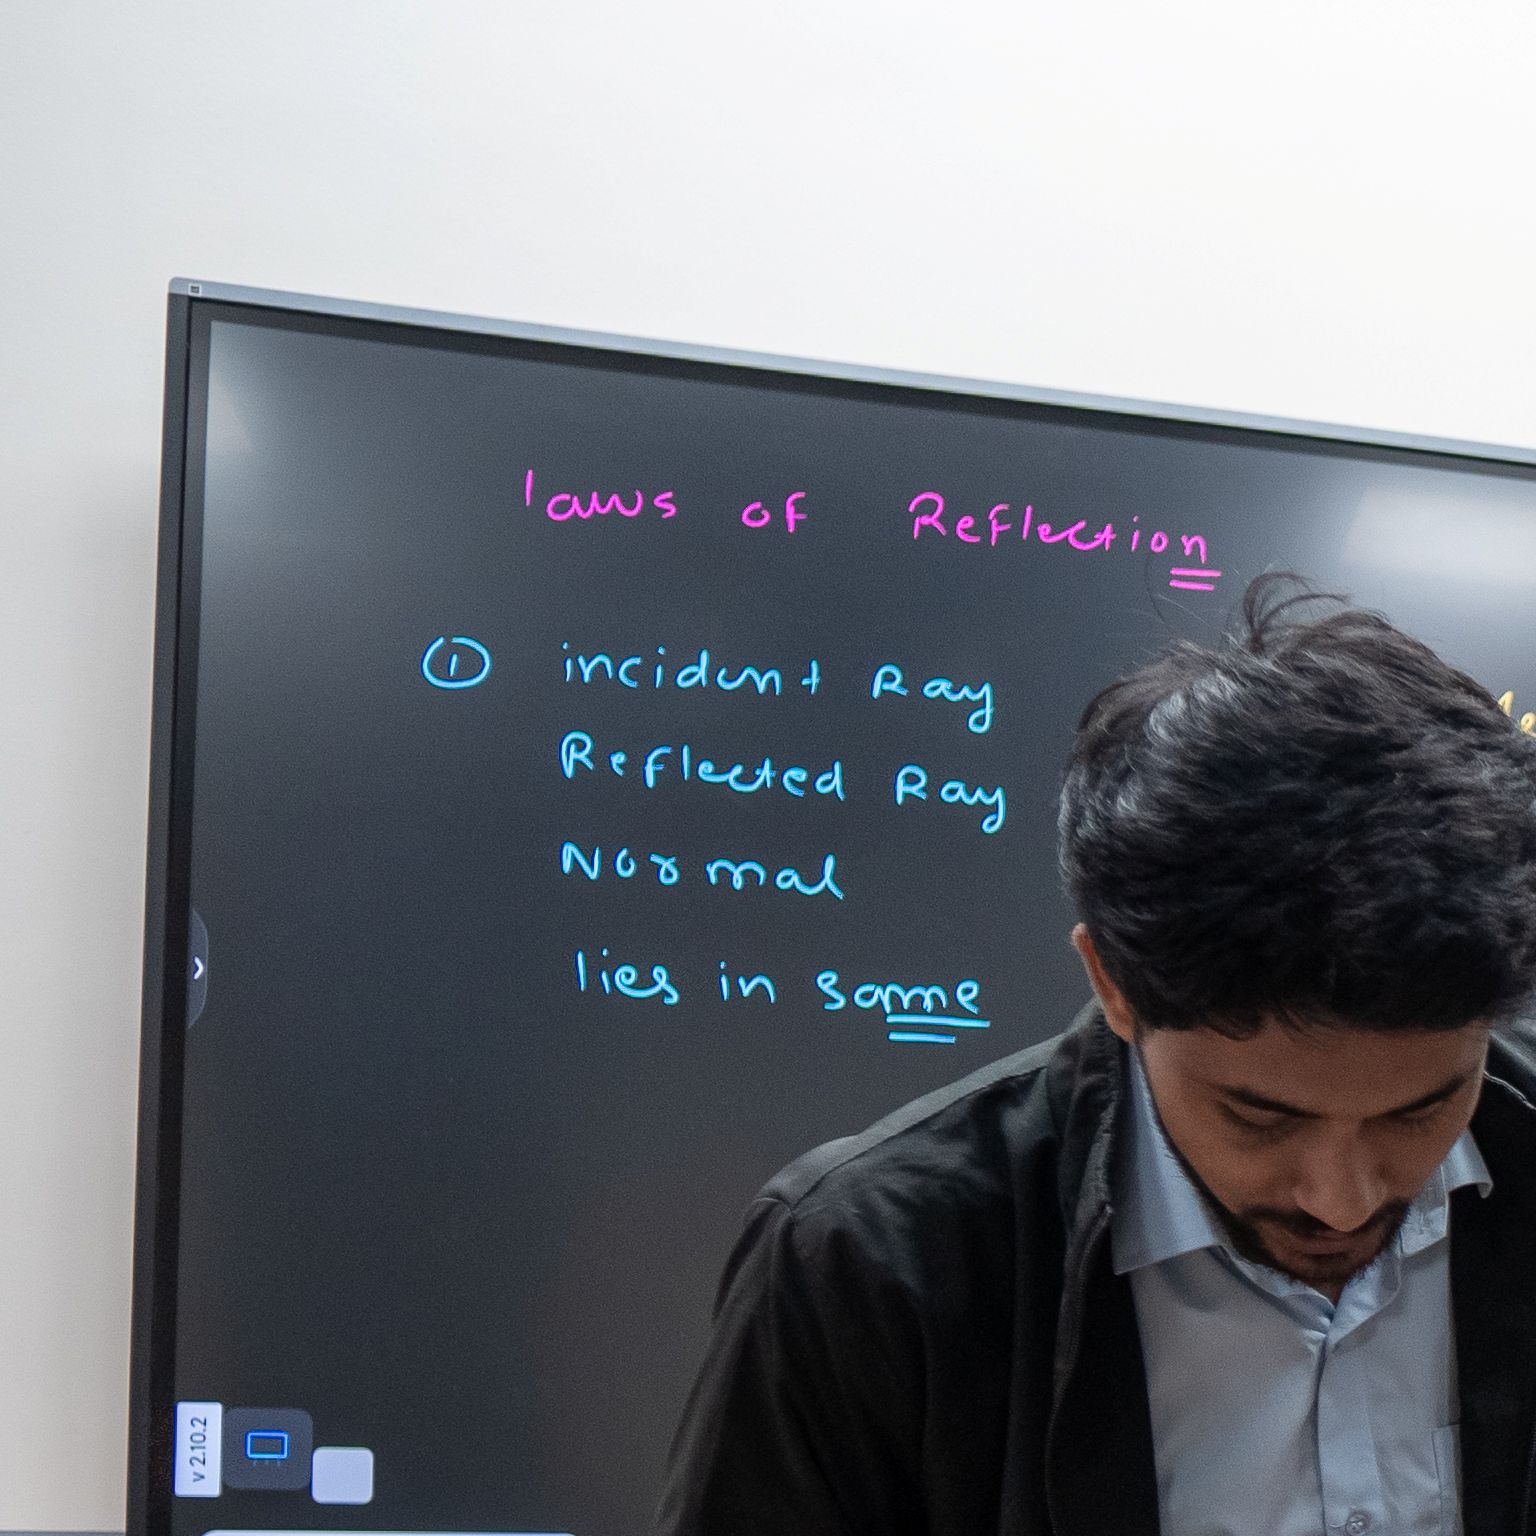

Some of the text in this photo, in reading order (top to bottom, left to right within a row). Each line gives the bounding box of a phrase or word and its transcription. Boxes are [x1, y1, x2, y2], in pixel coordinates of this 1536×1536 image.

[740, 490, 808, 535] of
[906, 490, 1209, 563] Reflection
[868, 662, 996, 735] Ray
[558, 729, 1008, 835] Reflected Ray
[558, 840, 846, 902] Normal
[574, 947, 981, 1016] lies in same
[188, 1416, 207, 1467] 2.10.2
